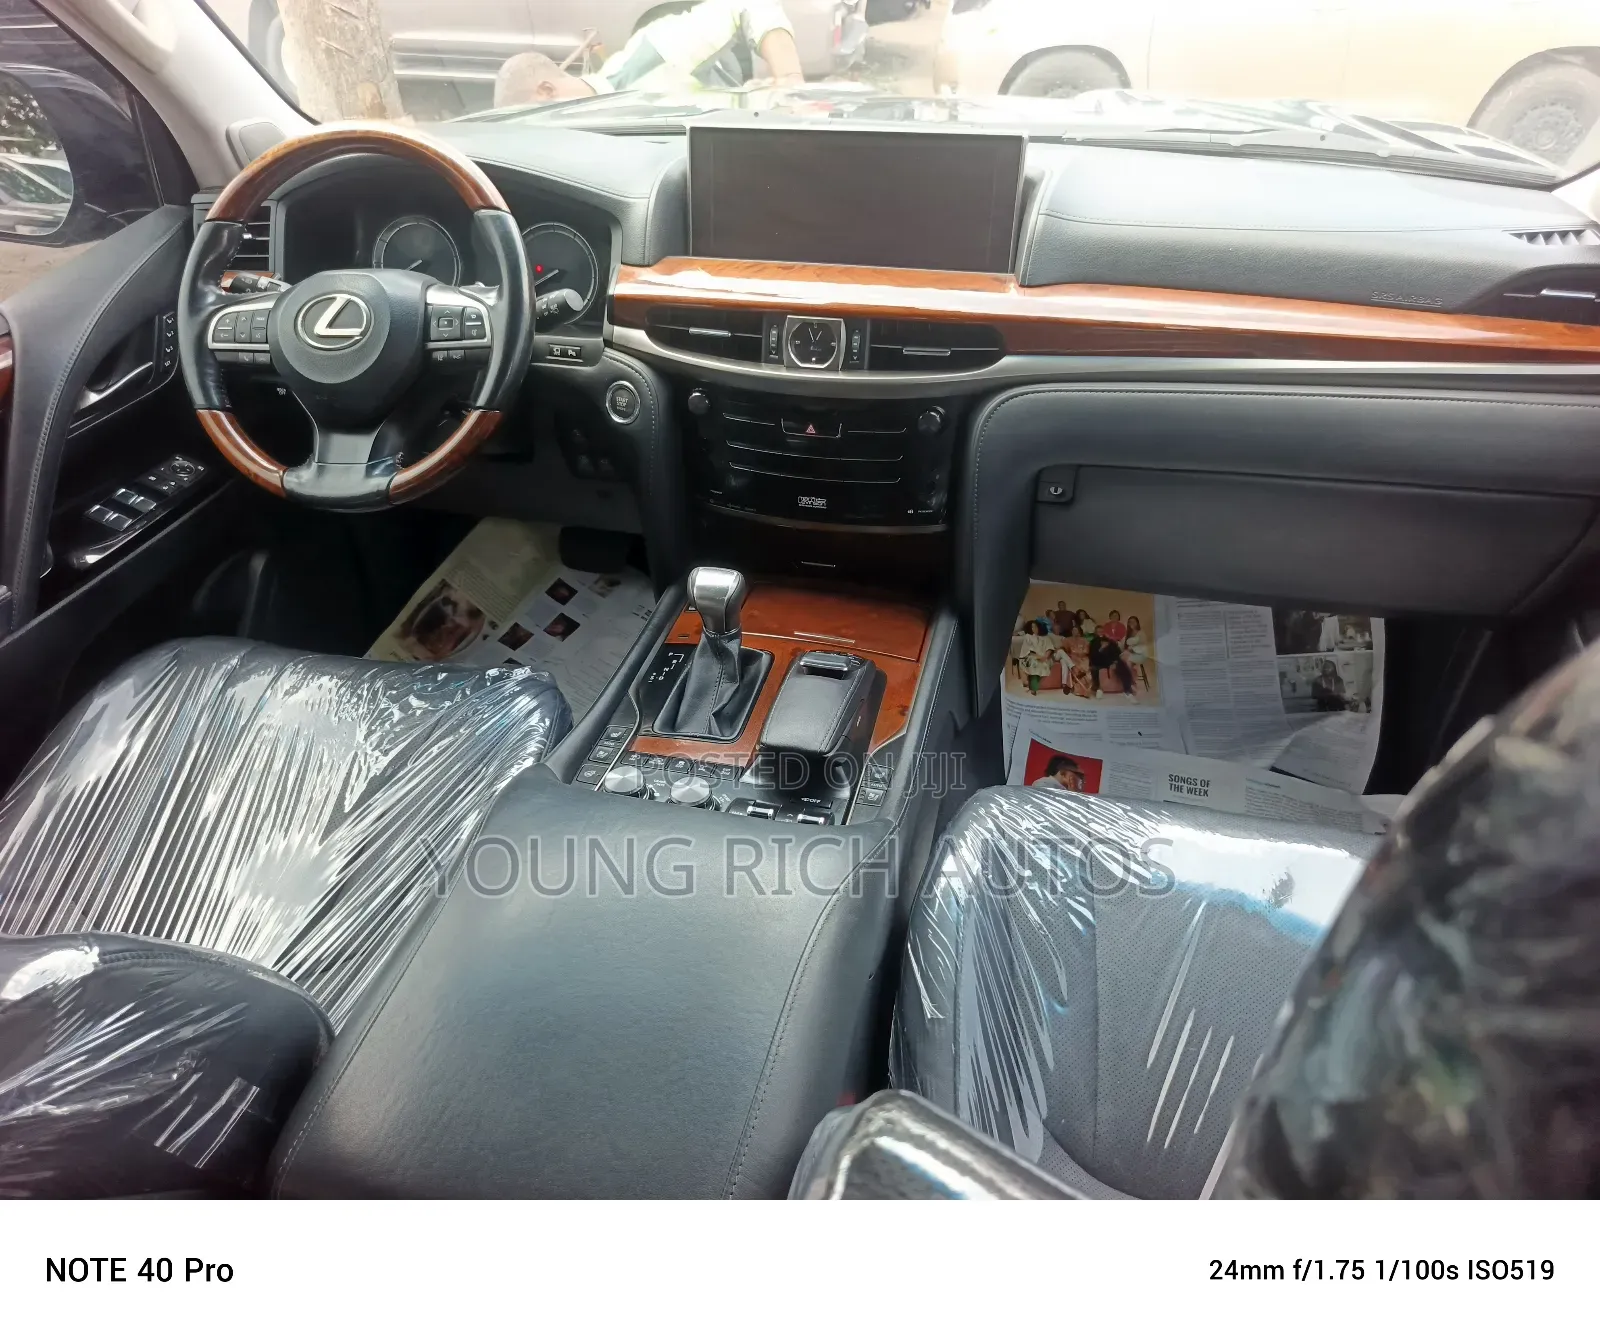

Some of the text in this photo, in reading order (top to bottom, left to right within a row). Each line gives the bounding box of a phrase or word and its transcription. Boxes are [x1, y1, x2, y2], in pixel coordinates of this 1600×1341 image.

[1168, 773, 1211, 789] SONGS OF
[1169, 782, 1209, 798] THE WEEK
